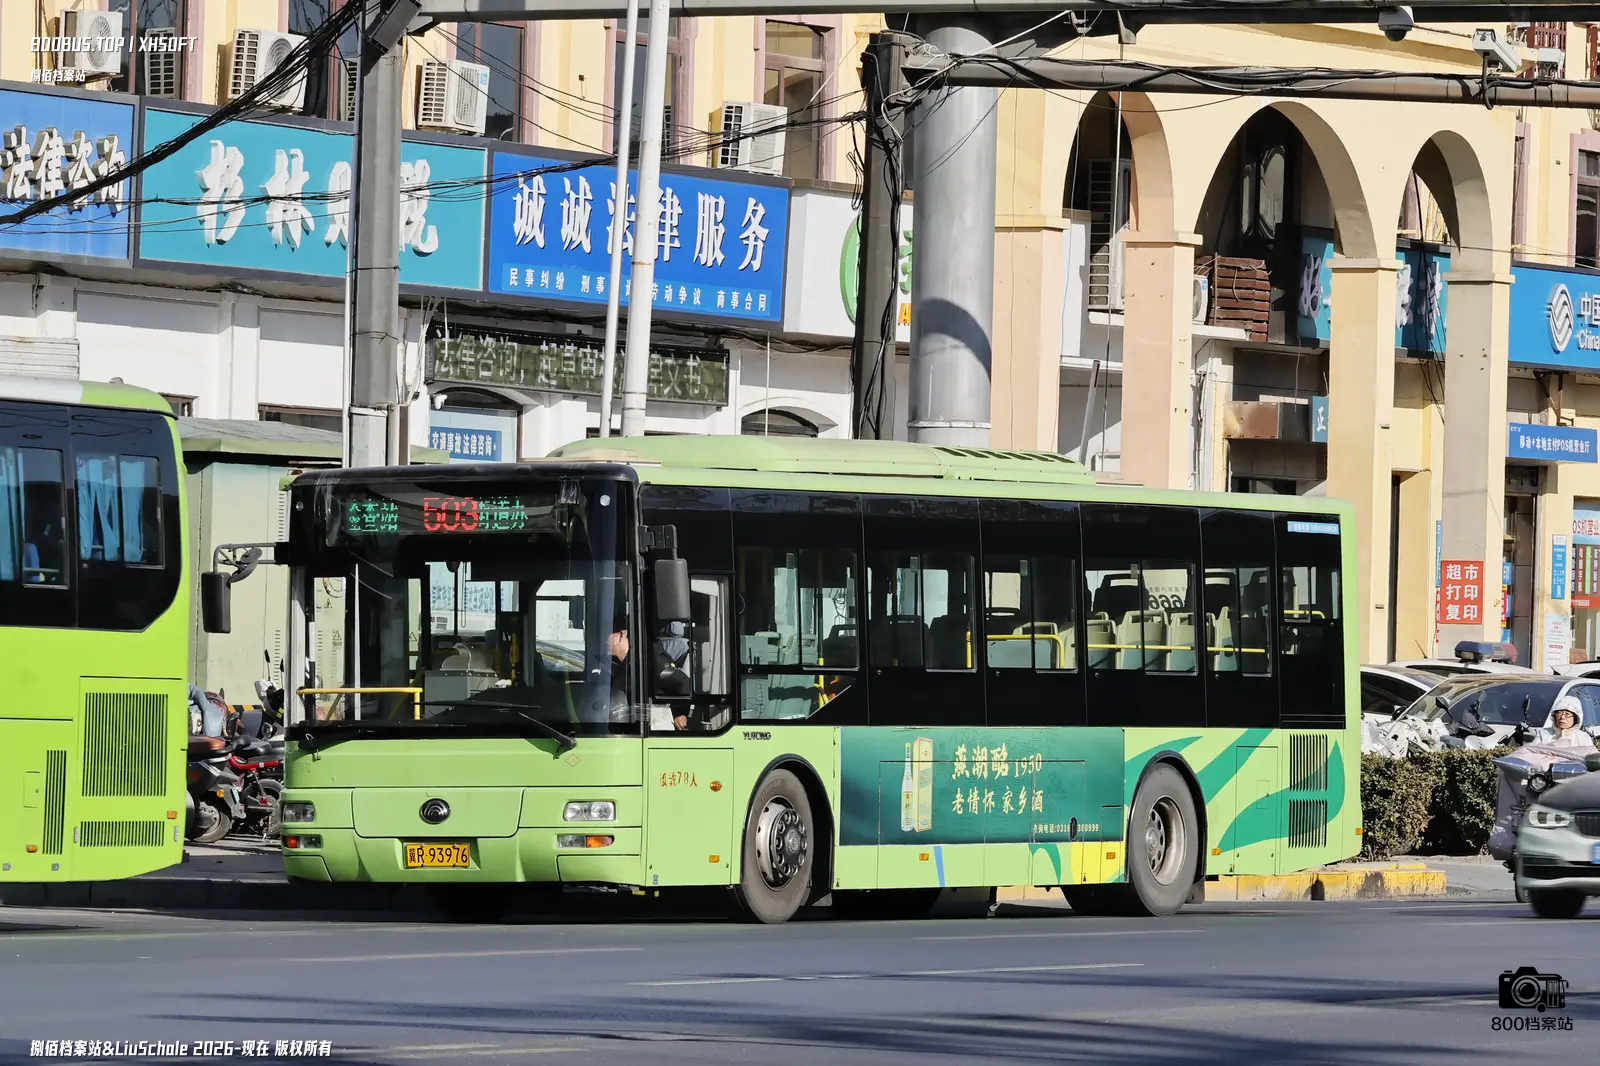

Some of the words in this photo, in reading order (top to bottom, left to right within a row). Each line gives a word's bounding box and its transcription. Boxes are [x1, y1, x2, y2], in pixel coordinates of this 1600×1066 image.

[2, 125, 125, 212] 法律咨询
[512, 171, 770, 271] 诚诚法律服务
[510, 268, 565, 291] 民事纠纷
[651, 282, 701, 305] 劳动争议
[717, 290, 767, 312] 商事合同
[423, 497, 479, 531] 503
[1446, 564, 1479, 580] 超市
[1446, 584, 1479, 600] 打印
[1446, 604, 1478, 620] 复印
[1014, 753, 1042, 778] 1950
